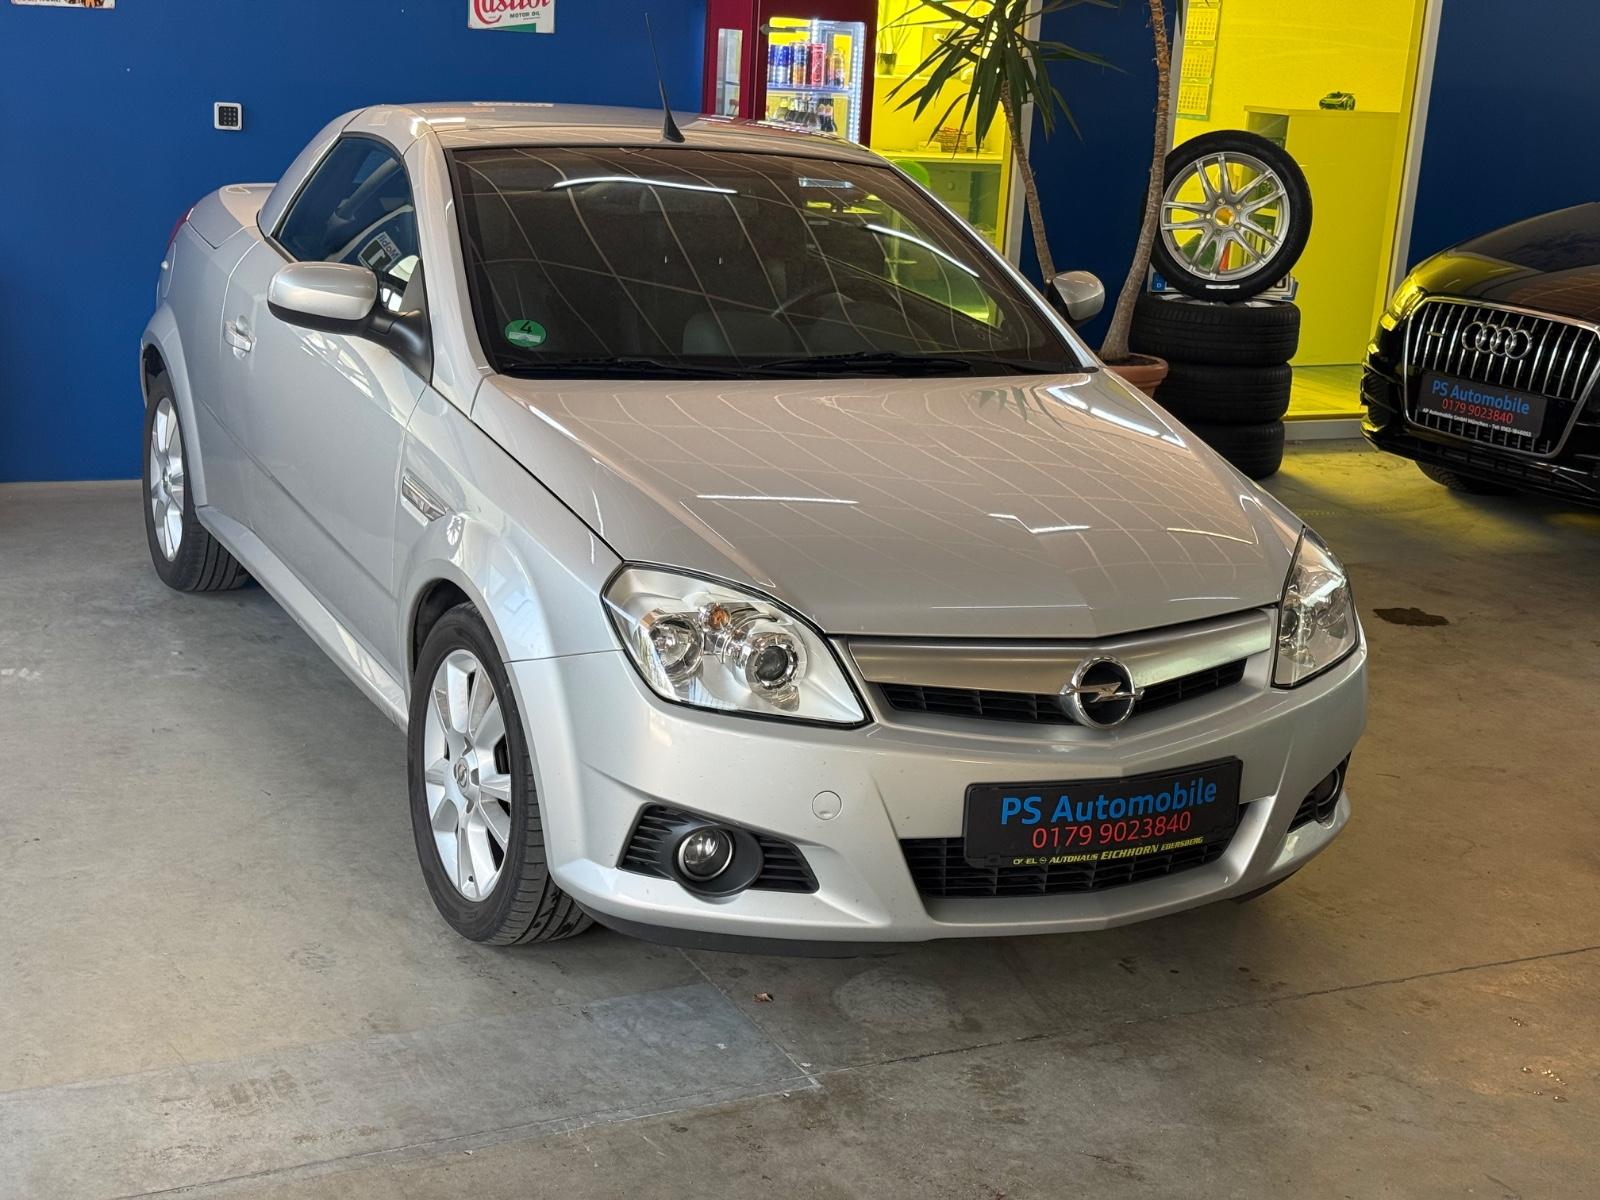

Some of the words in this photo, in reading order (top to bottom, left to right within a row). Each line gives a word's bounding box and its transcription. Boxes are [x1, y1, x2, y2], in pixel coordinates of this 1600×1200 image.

[473, 0, 551, 24] Casro
[520, 320, 533, 334] 4
[1433, 381, 1447, 396] PS
[1451, 385, 1530, 415] Automobile
[1442, 399, 1466, 413] 0179
[1468, 405, 1514, 425] 9023840
[1001, 796, 1041, 825] PS
[1050, 777, 1217, 823] Automobile
[1032, 825, 1093, 849] 0179
[1099, 811, 1192, 844] 9023840
[1049, 853, 1099, 864] AUTOHAUS
[1100, 844, 1159, 860] EICHHORN
[1160, 837, 1204, 851] EBERSBERG
